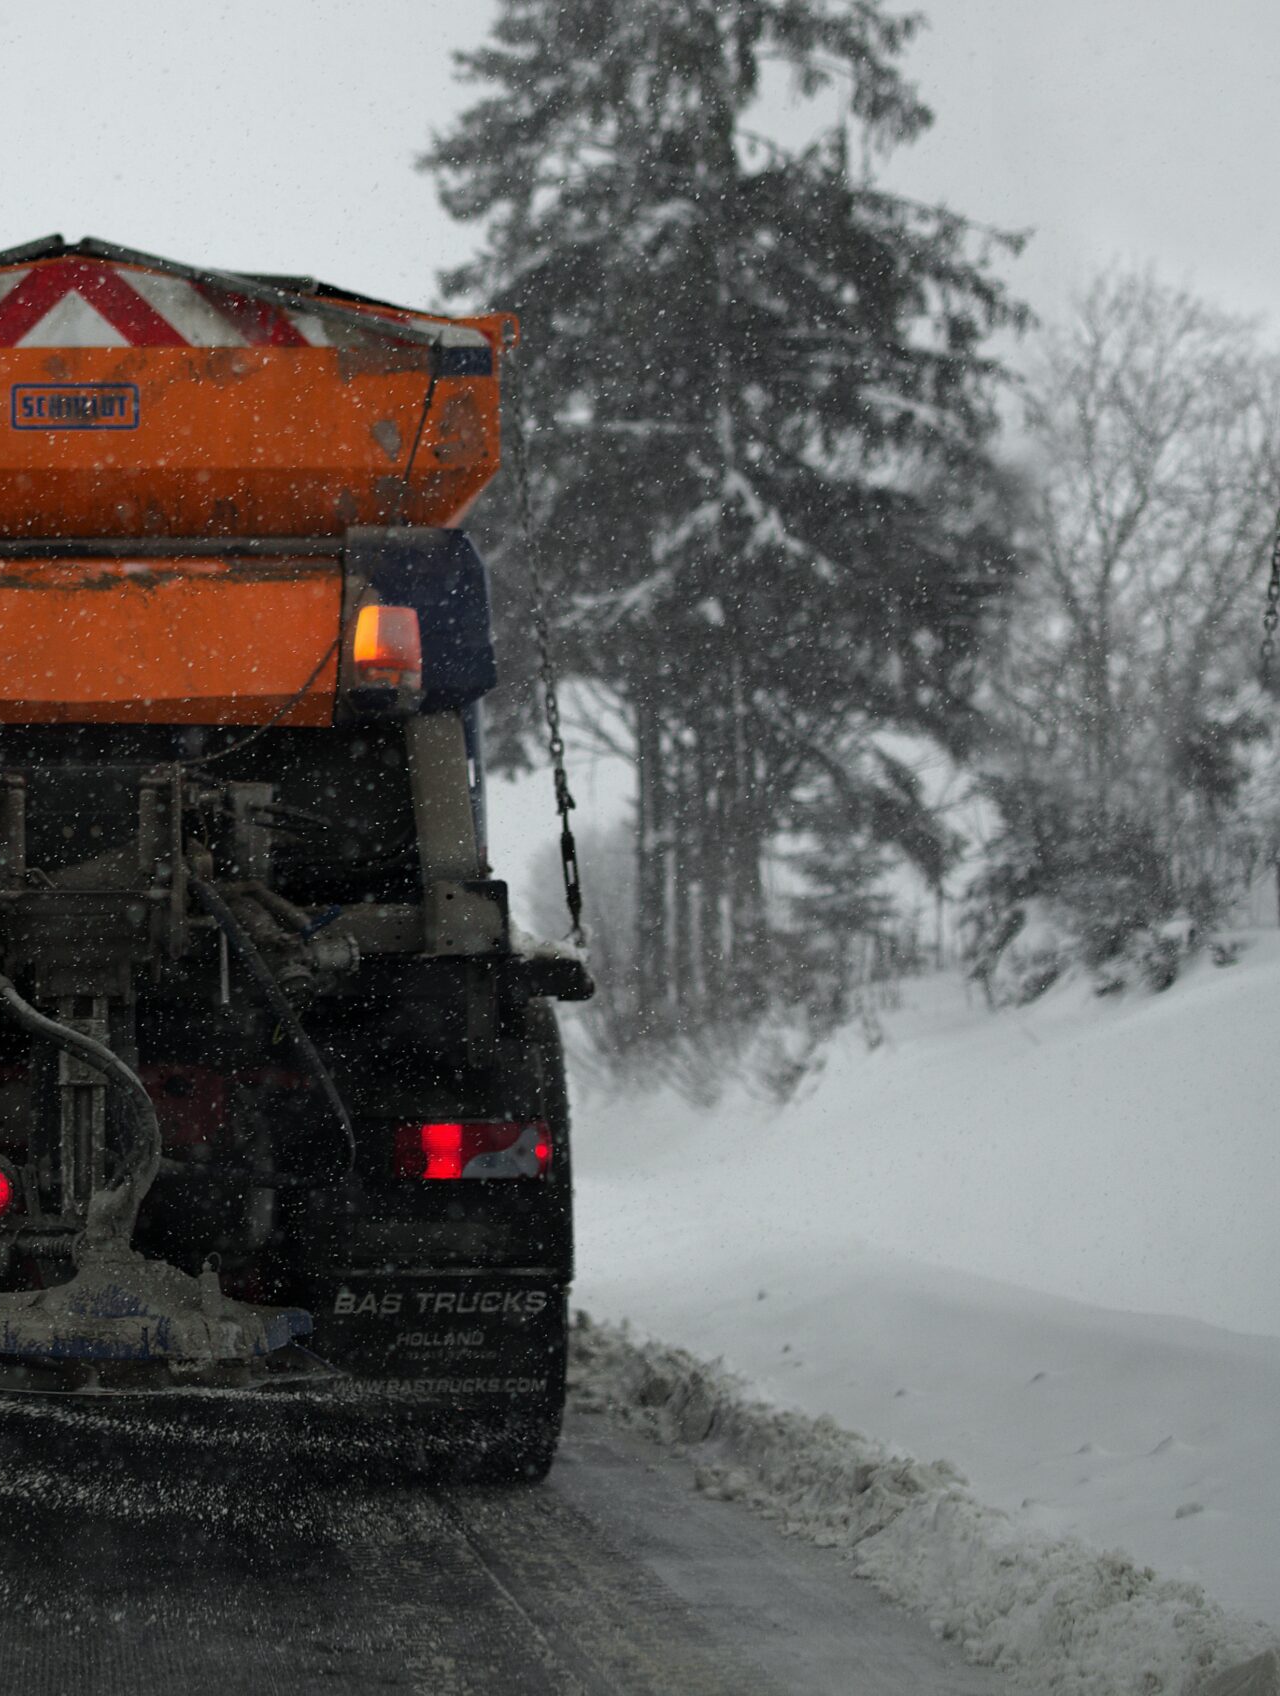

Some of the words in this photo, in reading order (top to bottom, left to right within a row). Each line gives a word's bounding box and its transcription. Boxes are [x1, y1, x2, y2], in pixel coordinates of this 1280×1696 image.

[22, 396, 126, 417] SCHMIDT
[334, 1293, 404, 1314] BAS
[417, 1291, 548, 1313] TRUCKS
[396, 1332, 485, 1346] HOLLAND
